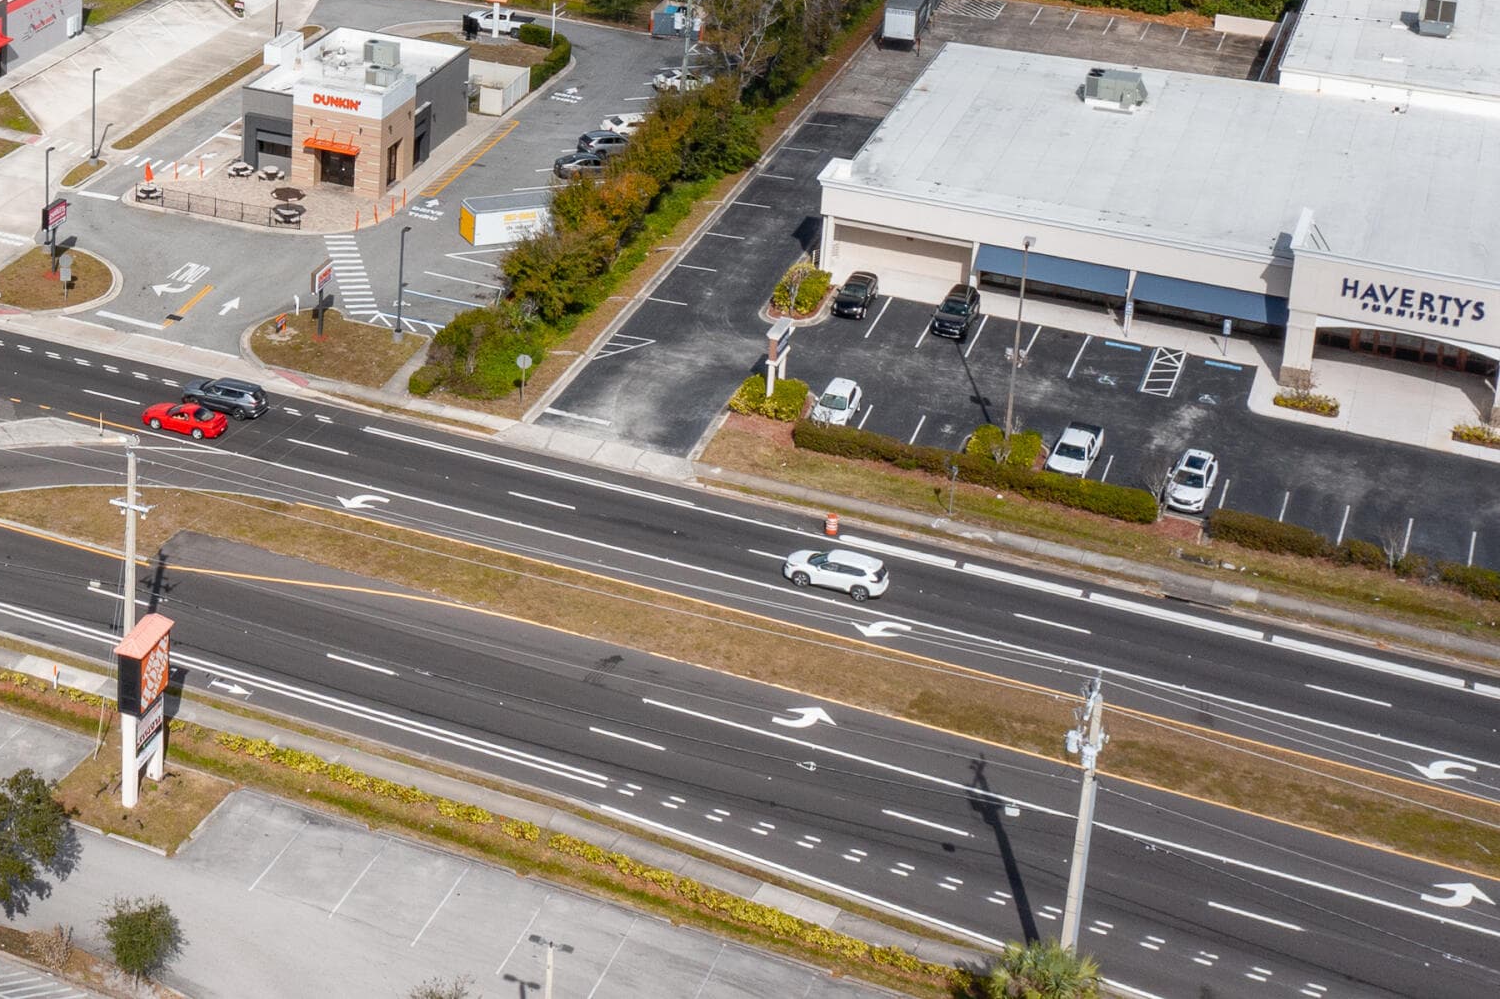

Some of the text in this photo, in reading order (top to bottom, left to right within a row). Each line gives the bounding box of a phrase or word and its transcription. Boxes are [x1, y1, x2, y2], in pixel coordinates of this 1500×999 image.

[313, 93, 361, 111] DUNKIN'
[408, 211, 438, 221] THRU
[411, 206, 444, 216] DRIVE
[166, 262, 210, 283] ONLY
[1341, 277, 1485, 321] HAVERTYS
[1361, 302, 1460, 327] FURNITURE
